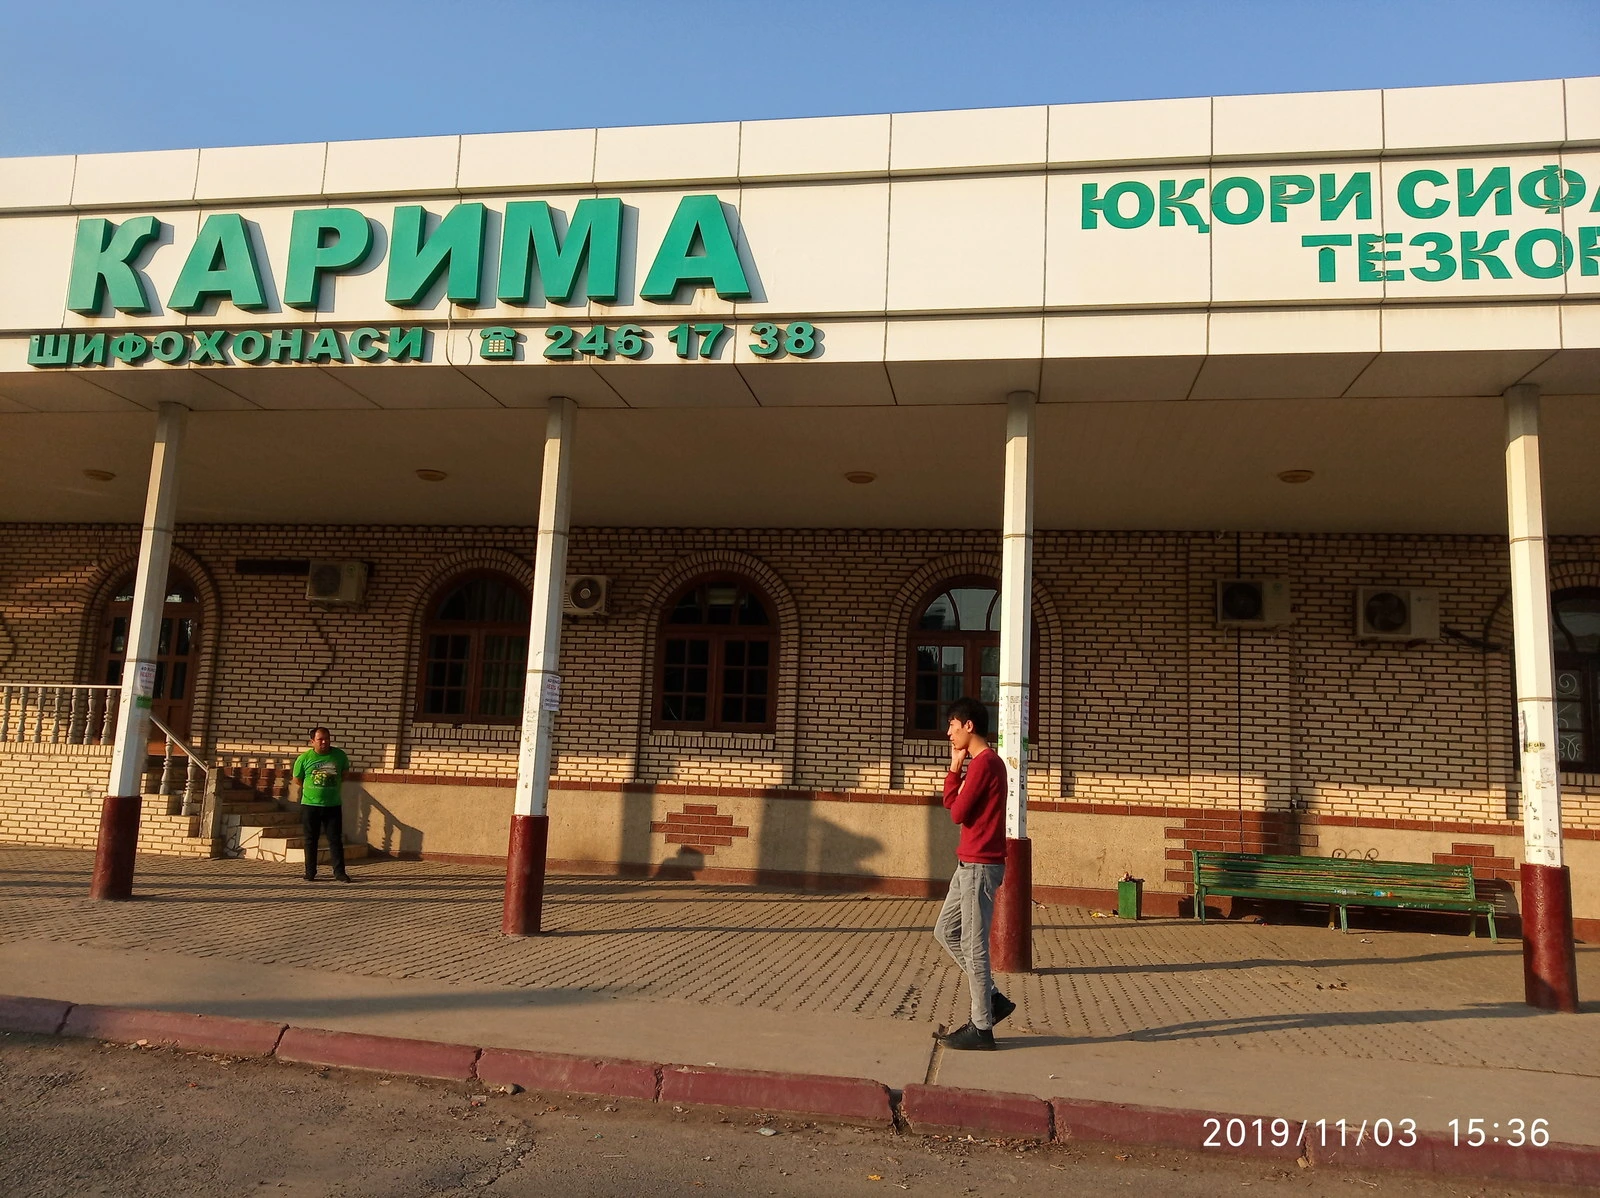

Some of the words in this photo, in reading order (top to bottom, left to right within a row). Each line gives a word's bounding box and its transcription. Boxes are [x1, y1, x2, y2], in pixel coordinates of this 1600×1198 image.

[1081, 171, 1374, 234] ЮҚОРИ
[1396, 163, 1600, 220] СИФ
[66, 193, 755, 315] КАРИМА
[27, 326, 425, 366] ШИФОХОНАСИ
[543, 323, 644, 359] 246
[668, 322, 725, 358] 17
[750, 321, 816, 357] 38
